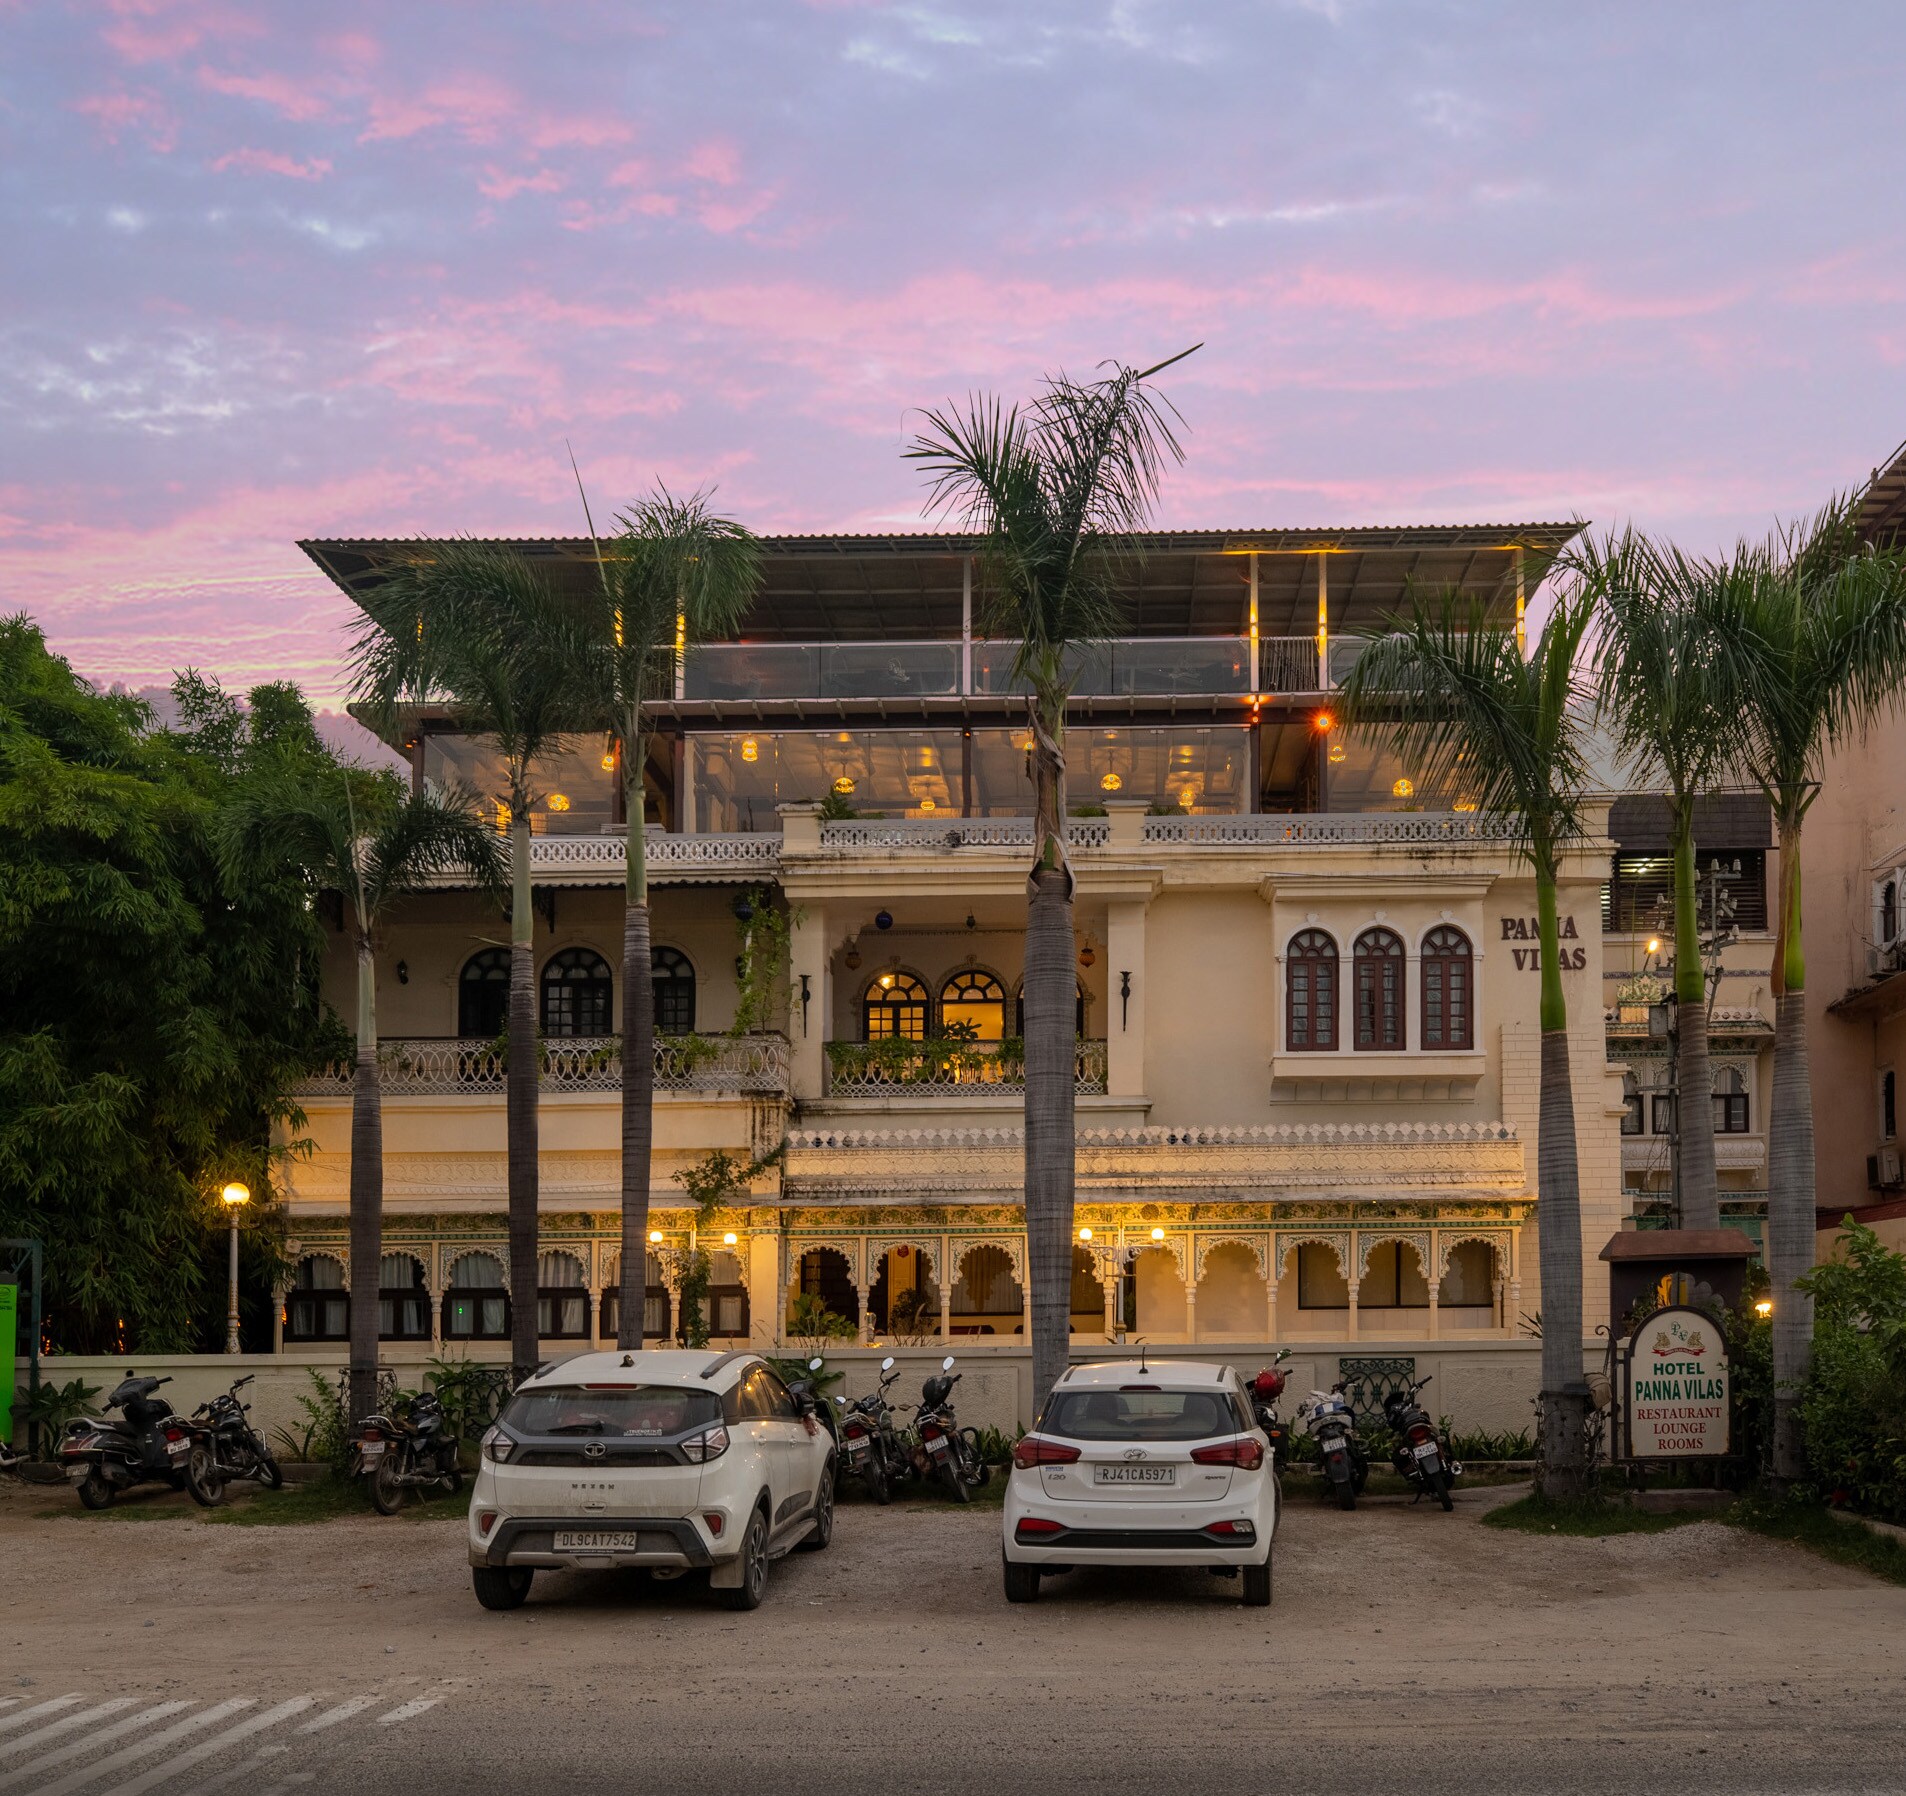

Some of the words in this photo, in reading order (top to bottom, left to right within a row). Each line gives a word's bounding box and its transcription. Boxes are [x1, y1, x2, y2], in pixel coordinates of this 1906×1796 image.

[1512, 947, 1586, 971] VIAS
[1653, 1363, 1705, 1376] HOTEL
[1635, 1380, 1681, 1401] PANNA
[1684, 1378, 1724, 1400] VILAS
[1637, 1407, 1722, 1420] RESTAURANT
[1653, 1423, 1707, 1435] LOUNGE
[1658, 1437, 1704, 1450] ROOMS
[1102, 1468, 1173, 1481] RJ41CA5971
[562, 1533, 635, 1547] DL9CAT7542
